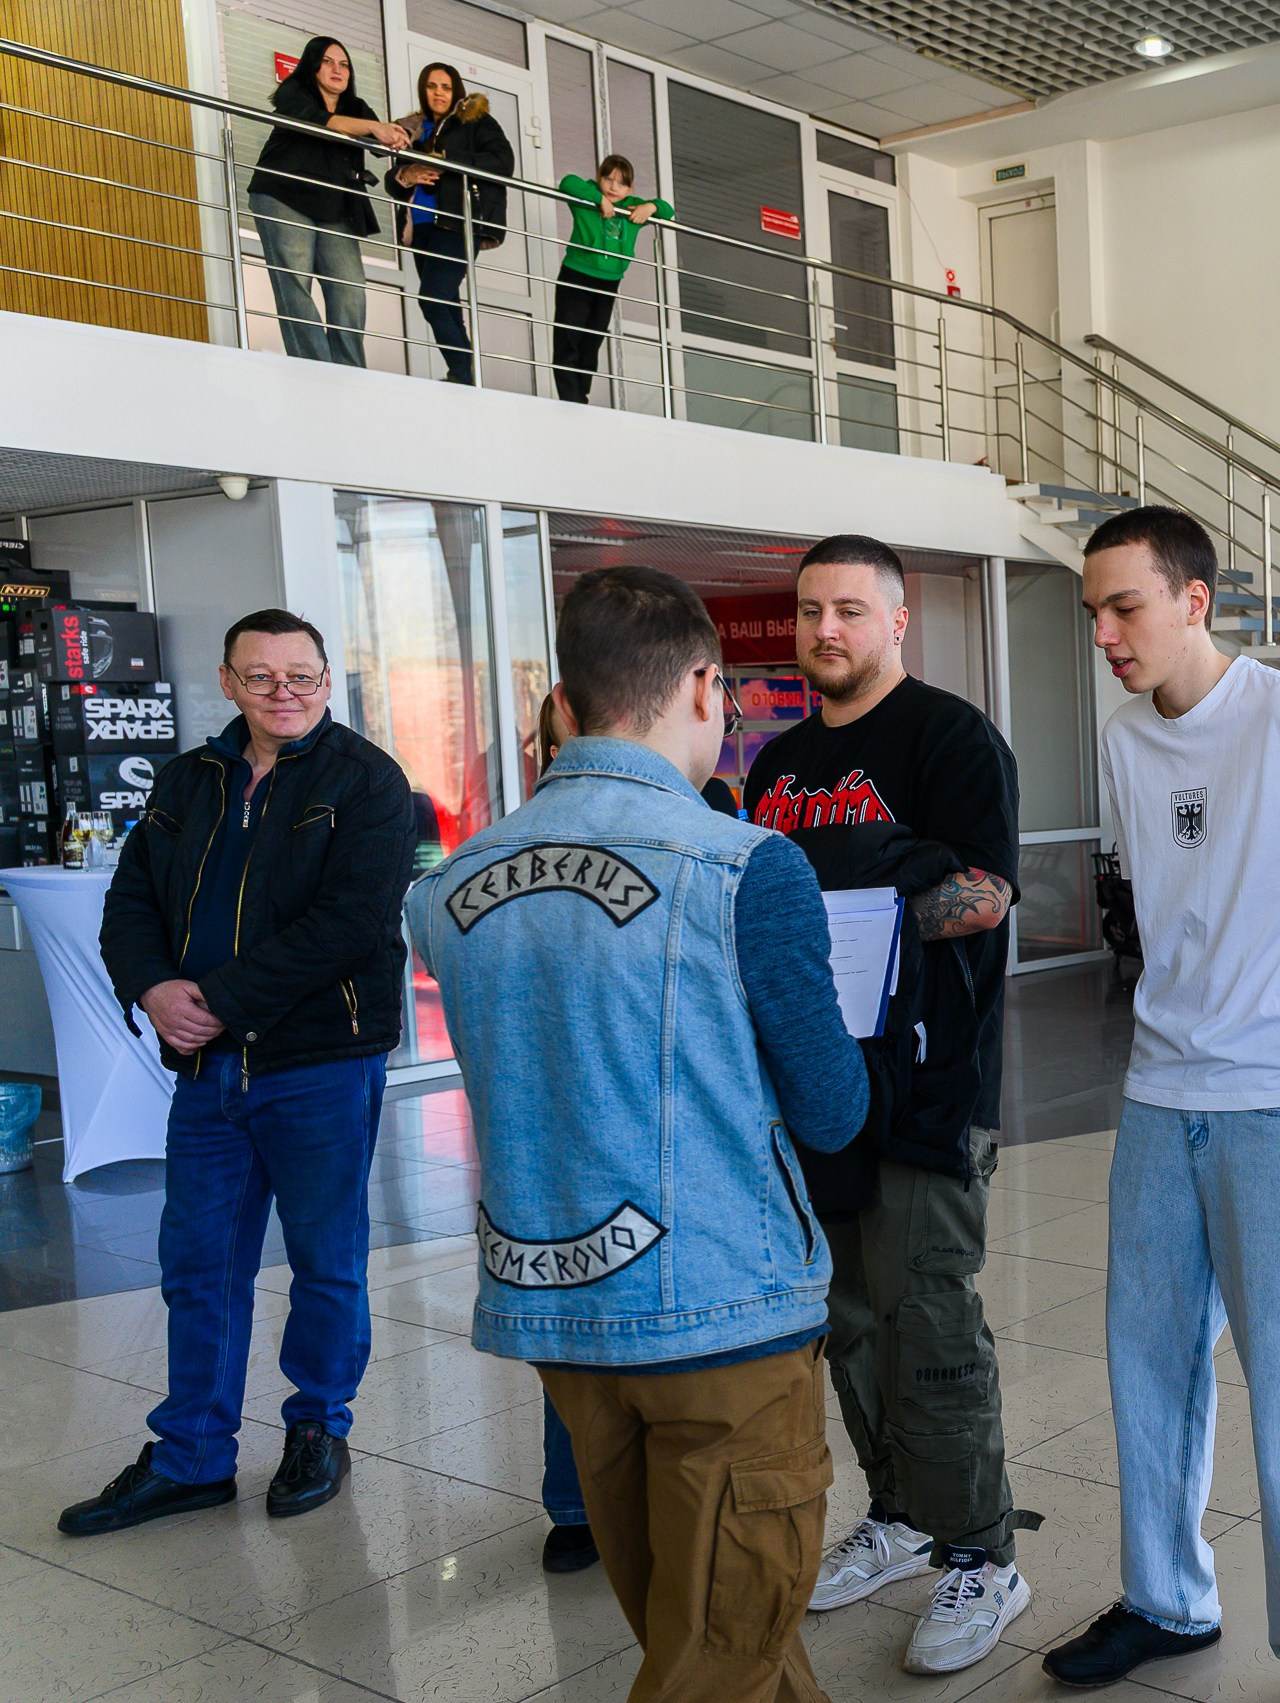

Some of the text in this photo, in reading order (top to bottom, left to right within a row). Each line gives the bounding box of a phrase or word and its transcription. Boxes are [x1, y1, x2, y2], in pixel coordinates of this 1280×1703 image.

[718, 618, 797, 639] А ВАШ ВЫБ
[61, 615, 84, 679] starks
[80, 630, 90, 665] safe ride
[84, 698, 173, 719] SPARX
[86, 720, 176, 740] SPARX
[100, 791, 152, 810] SPA
[1174, 790, 1204, 801] VULTURES
[459, 851, 644, 911] CERBERUS
